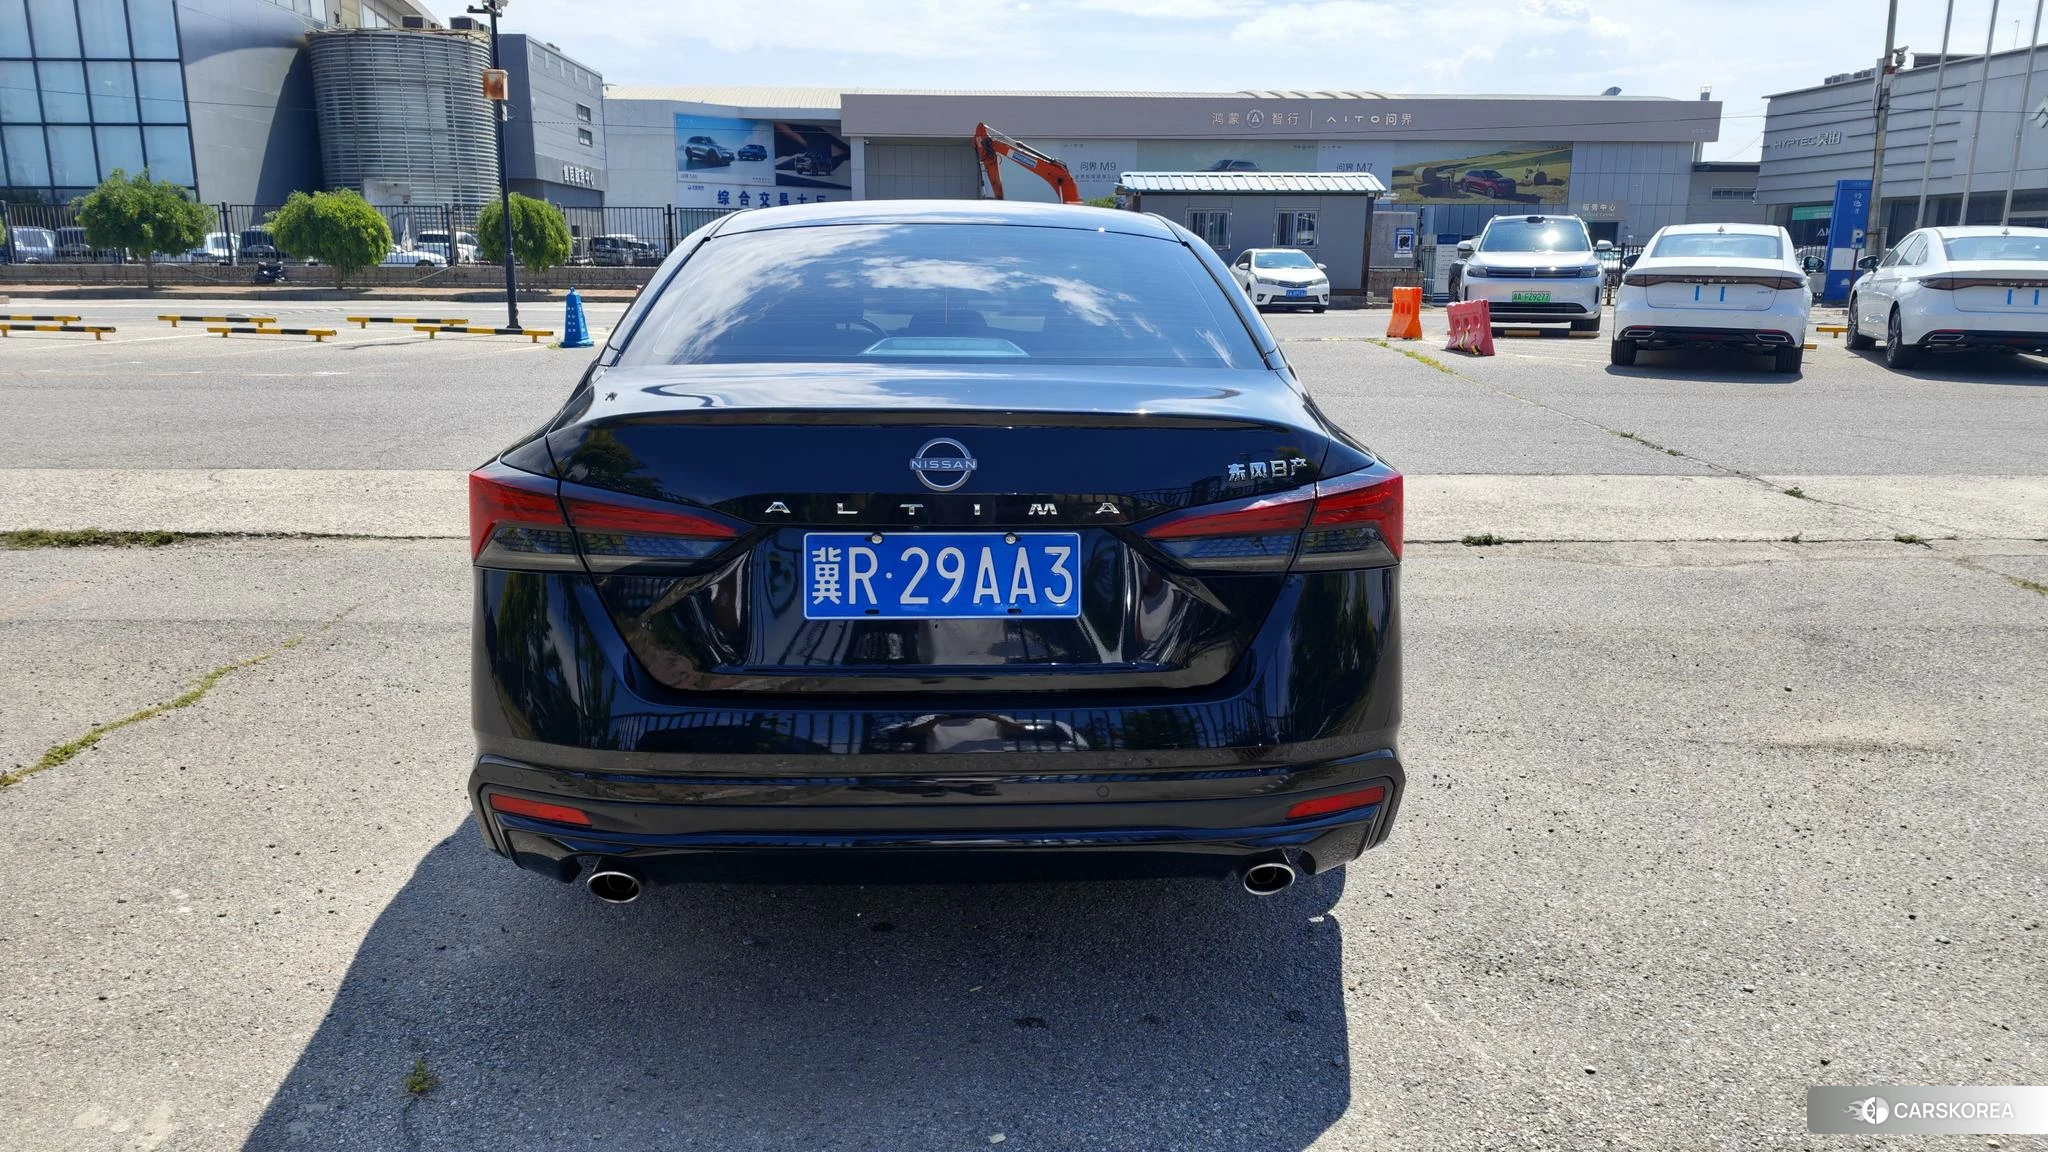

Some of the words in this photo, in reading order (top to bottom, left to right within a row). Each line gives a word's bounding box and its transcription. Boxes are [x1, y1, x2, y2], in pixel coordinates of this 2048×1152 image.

[1211, 112, 1240, 125] 鸿蒙
[1271, 112, 1300, 125] 智行
[1100, 162, 1116, 171] M9
[1356, 162, 1373, 172] M7
[1852, 229, 1864, 244] P
[911, 460, 976, 469] NISSAN
[1227, 457, 1307, 482] 东风日产
[765, 501, 1121, 515] ALTIMA
